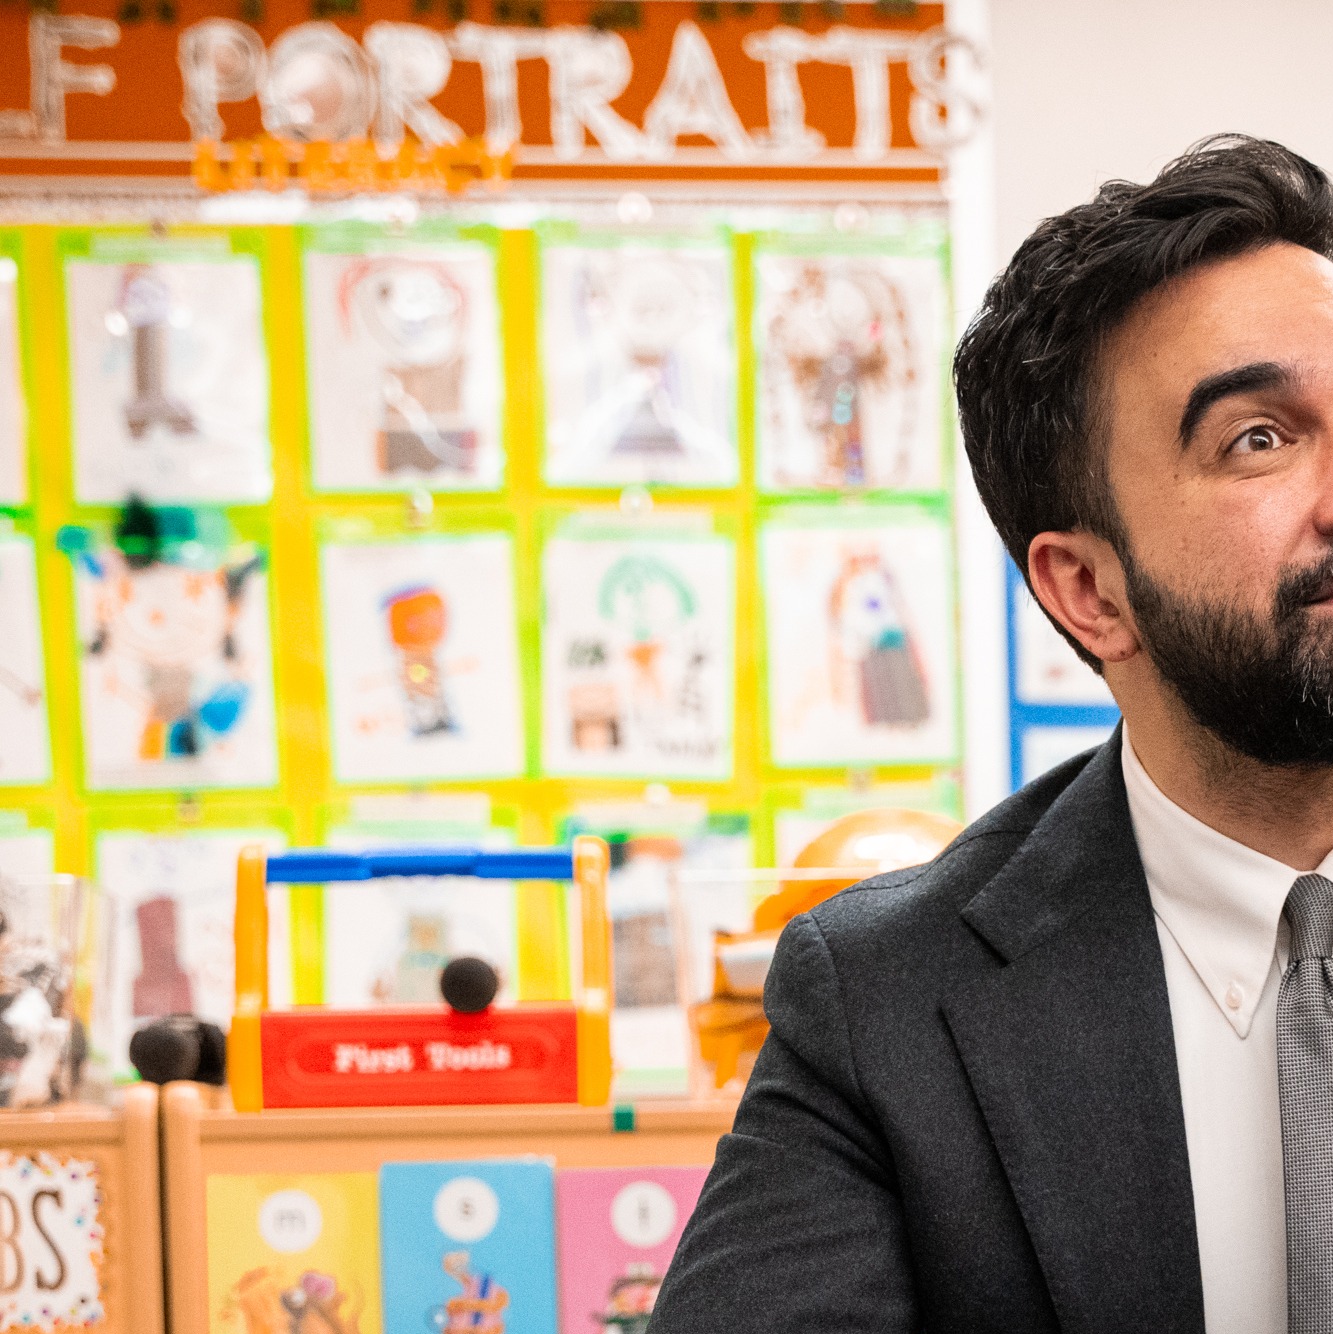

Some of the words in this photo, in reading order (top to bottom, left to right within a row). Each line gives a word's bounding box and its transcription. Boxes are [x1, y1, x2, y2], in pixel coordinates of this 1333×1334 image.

[0, 13, 121, 147] F
[177, 17, 985, 162] PORTRAITS
[334, 1042, 414, 1073] First
[425, 1040, 512, 1071] Tools
